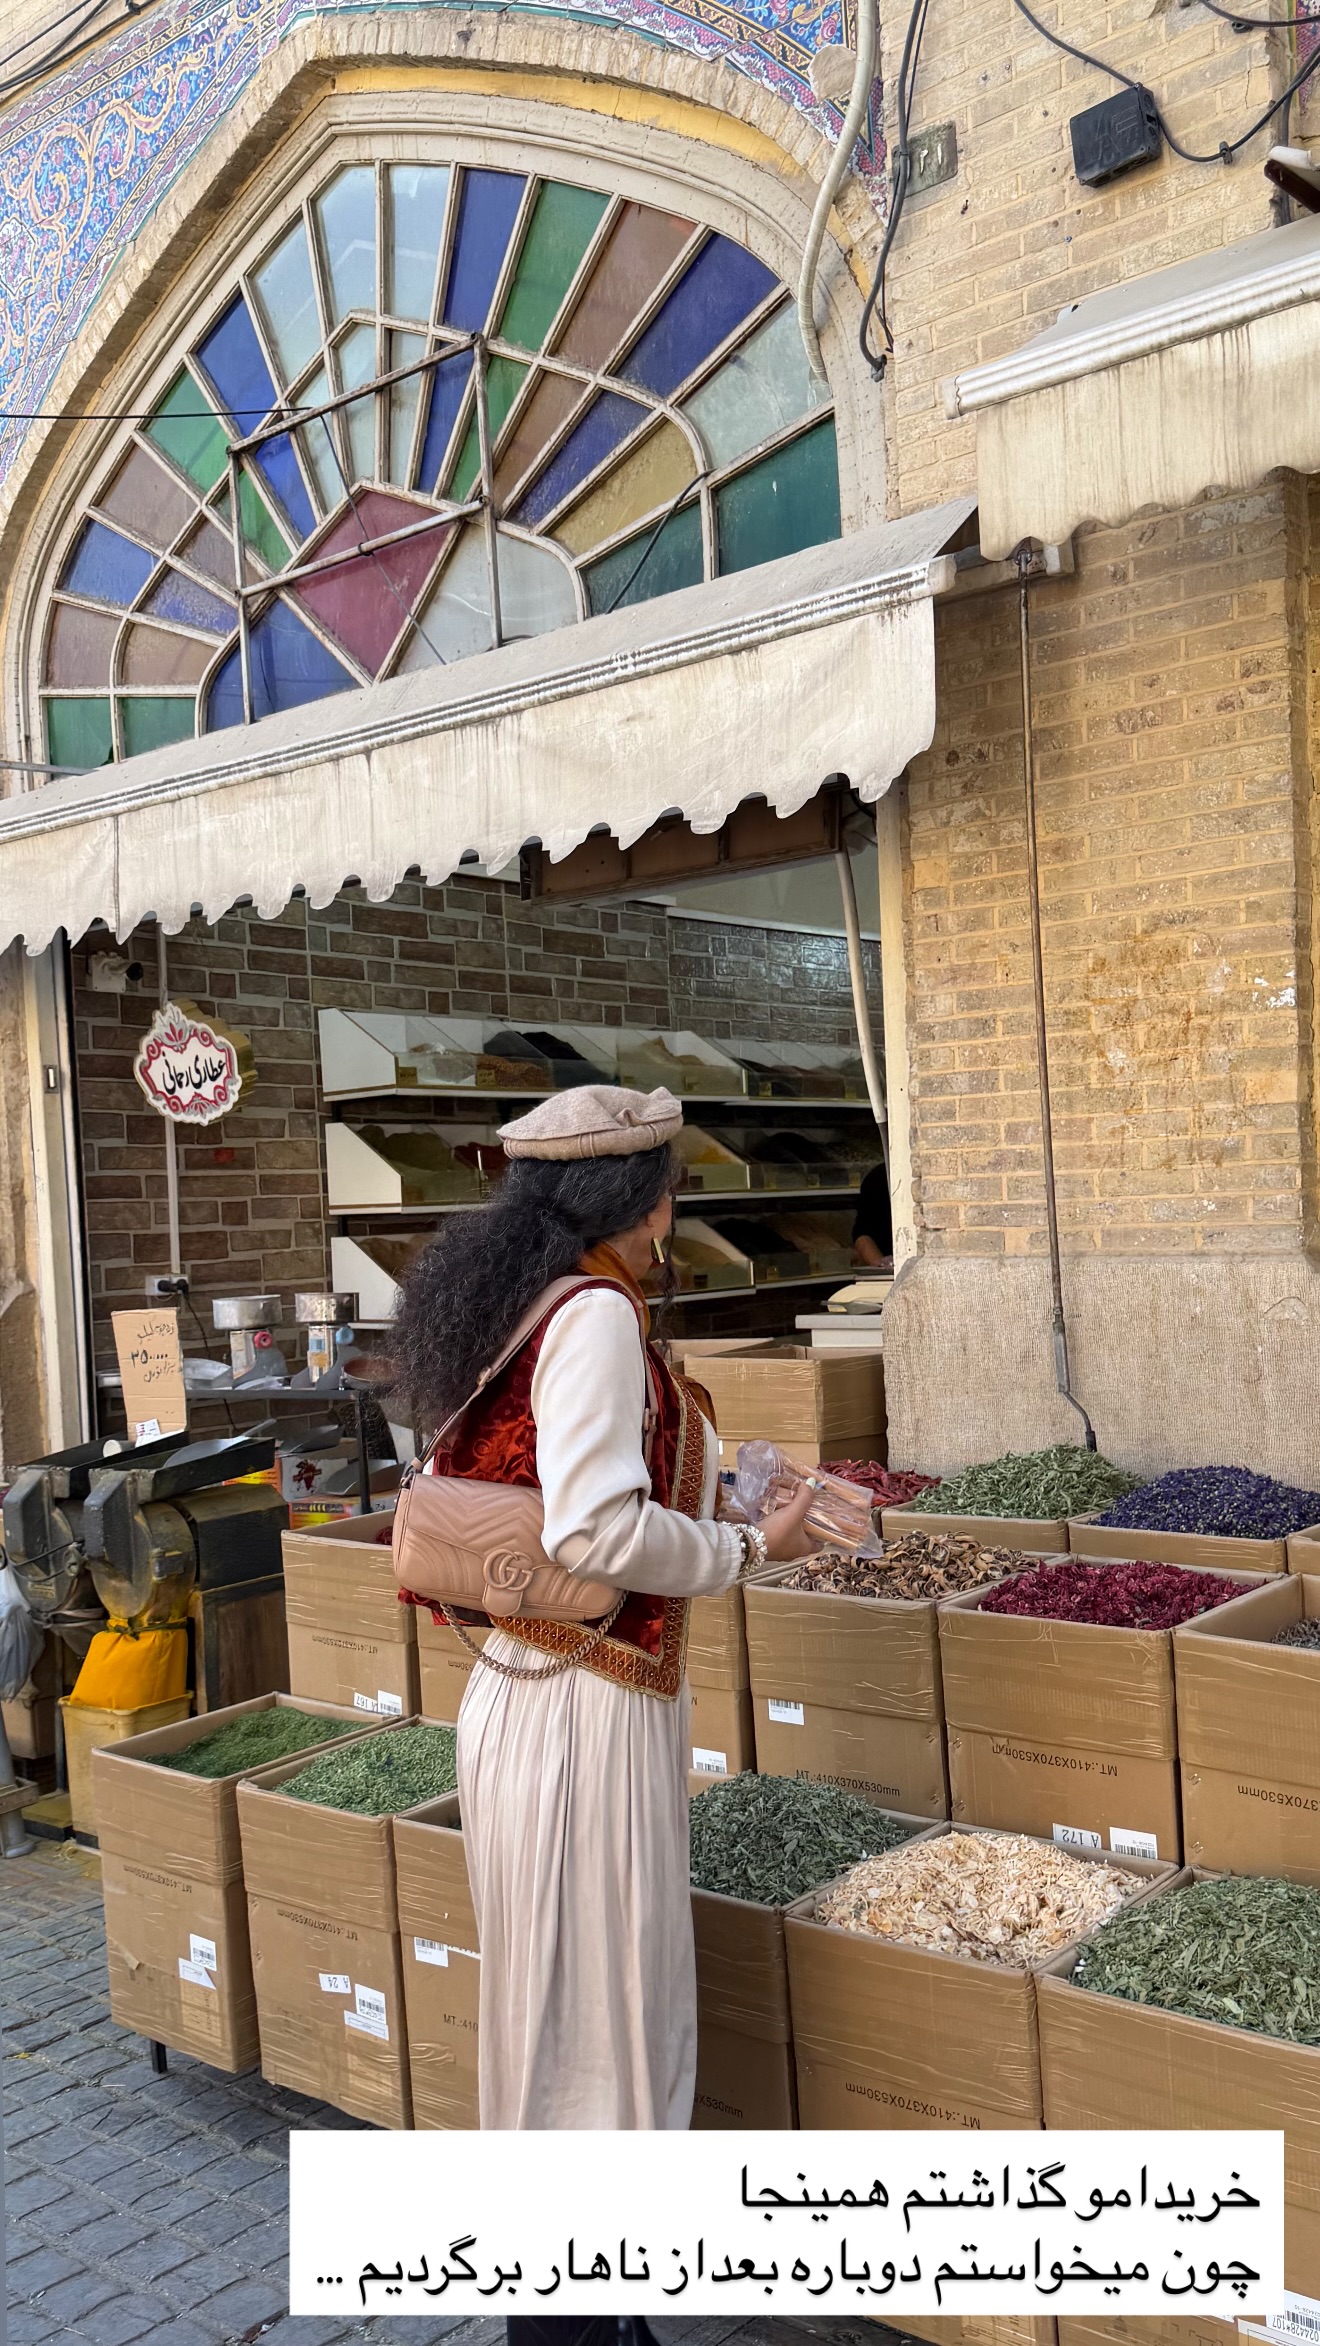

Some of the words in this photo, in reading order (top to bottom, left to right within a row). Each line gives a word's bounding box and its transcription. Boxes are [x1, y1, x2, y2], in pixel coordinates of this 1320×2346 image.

[189, 1054, 226, 1089] عطاری
[1237, 1784, 1320, 1814] 370X530mm
[1061, 1829, 1084, 1845] 172
[1091, 1834, 1099, 1849] A
